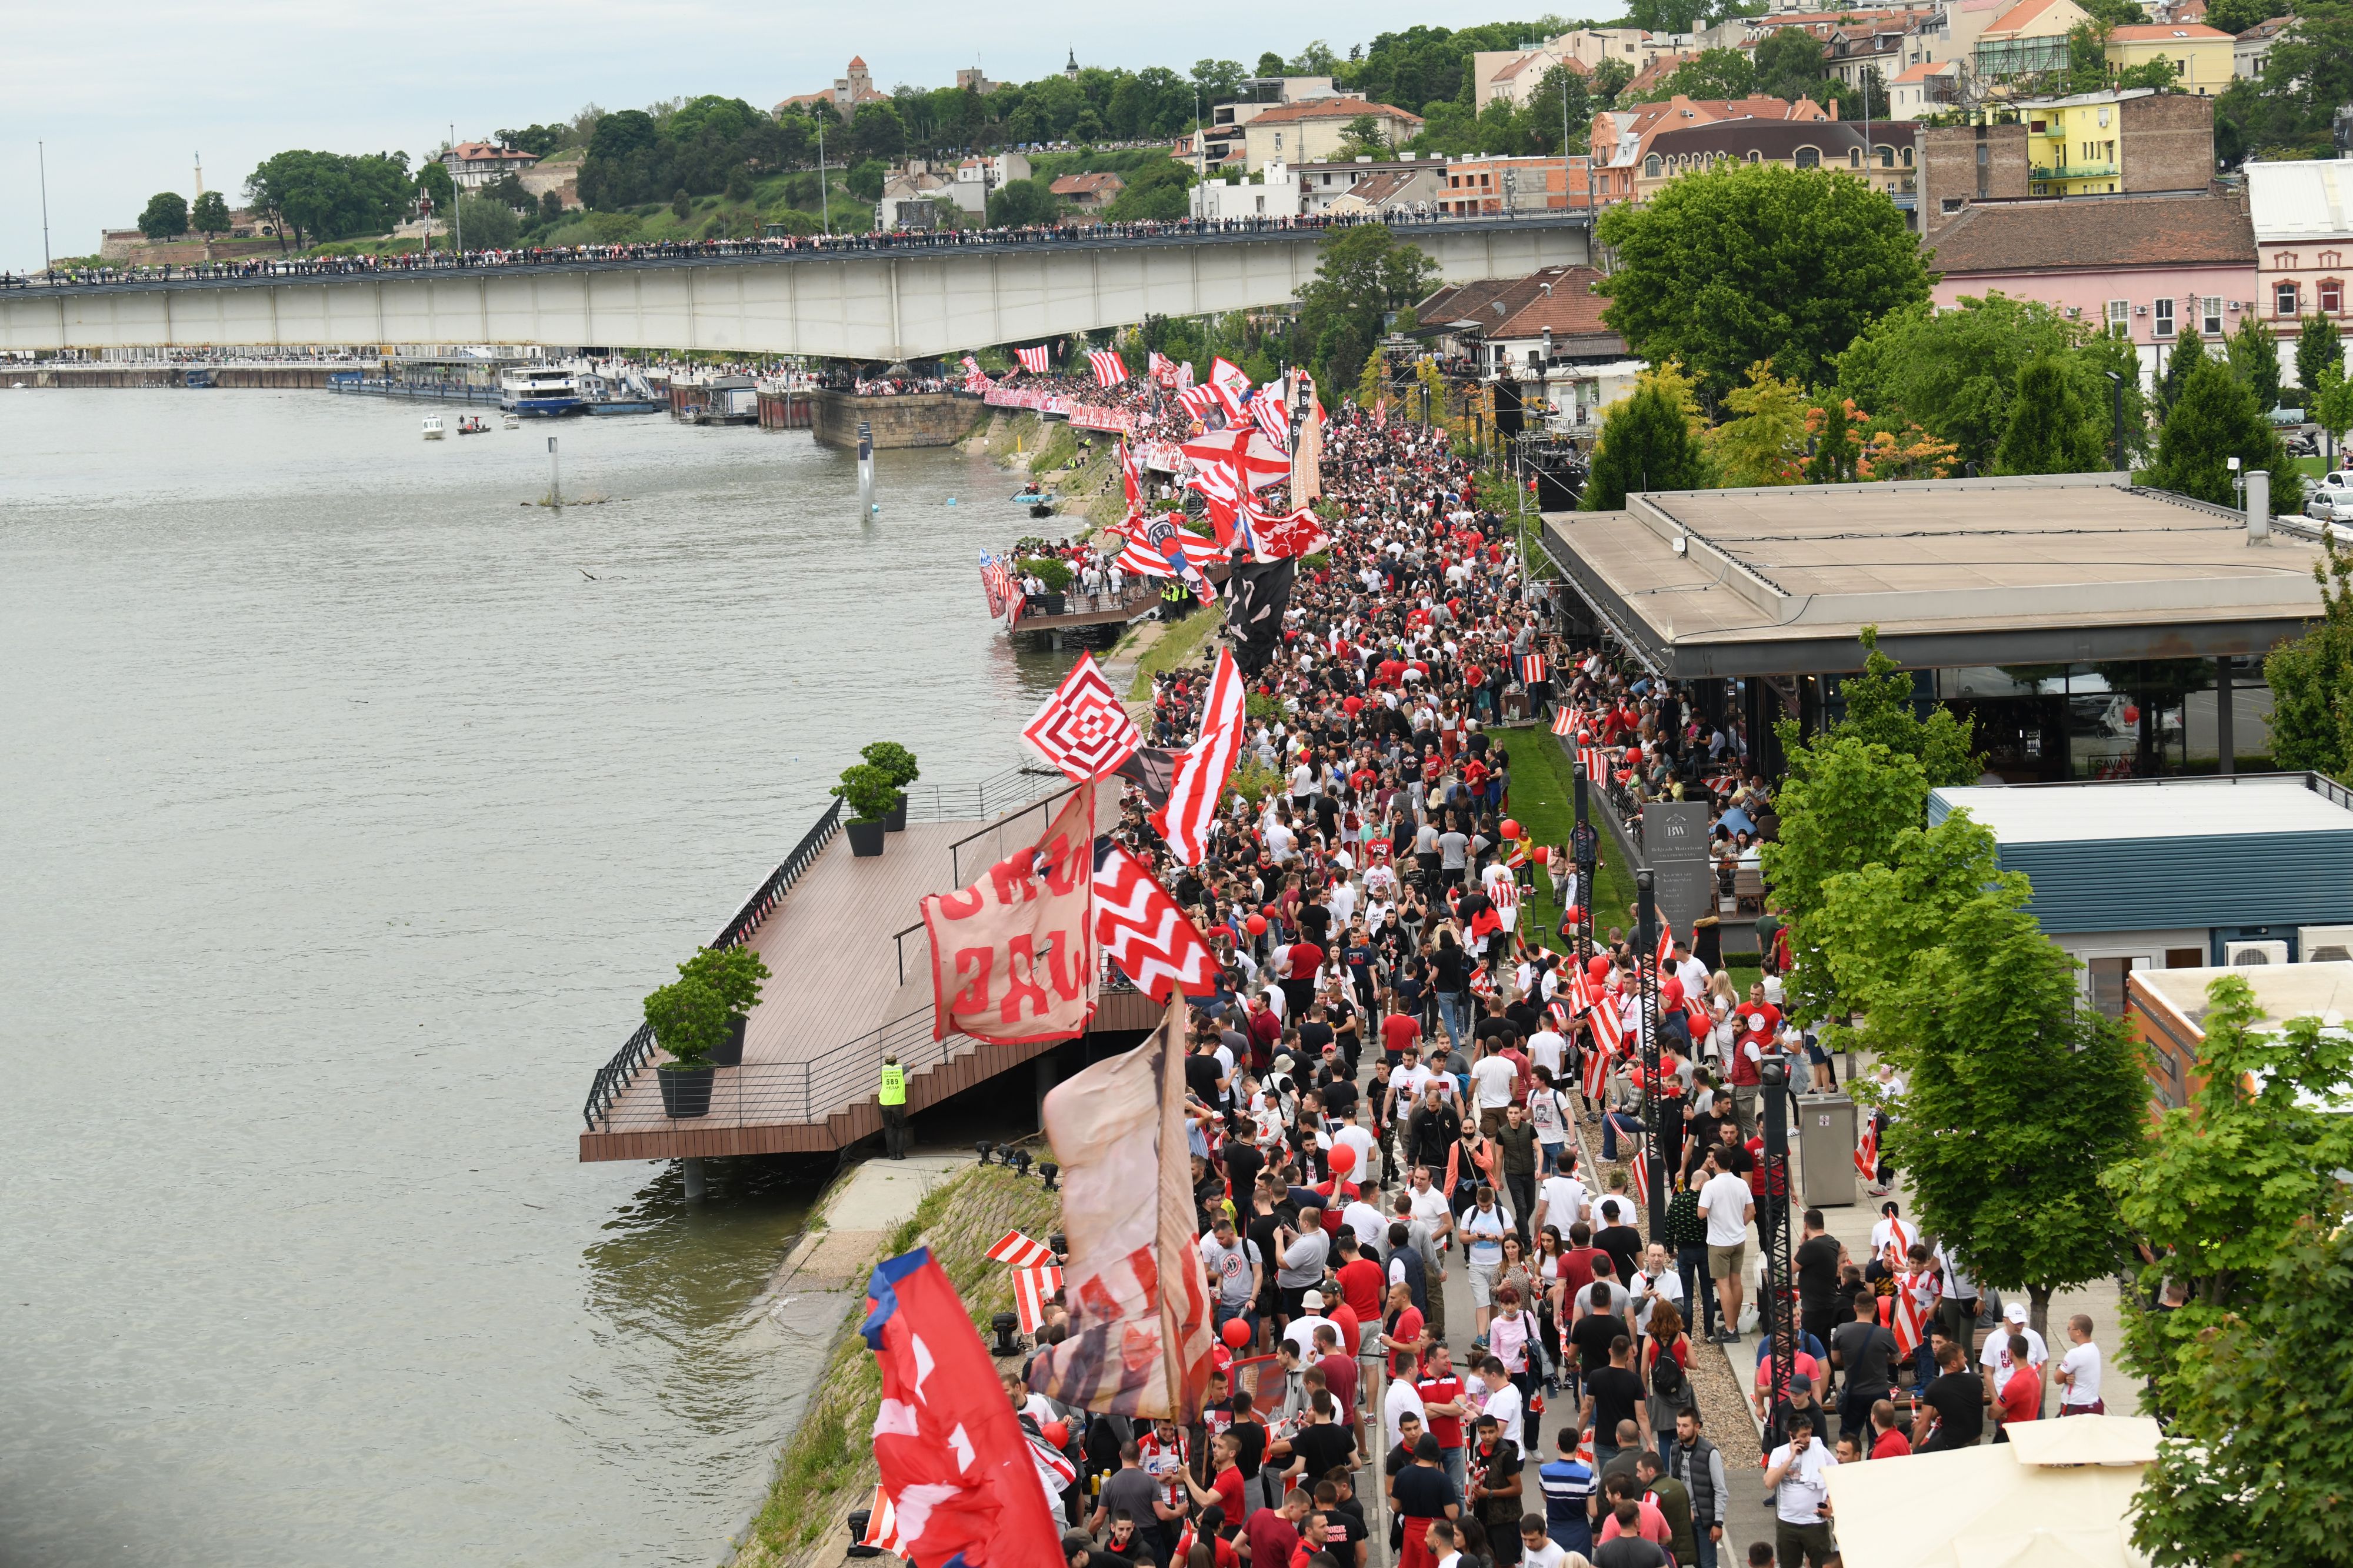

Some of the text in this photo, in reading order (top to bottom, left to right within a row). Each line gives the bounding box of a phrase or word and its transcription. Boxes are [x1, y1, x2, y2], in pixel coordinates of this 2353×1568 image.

[1301, 396, 1313, 405] BW
[1298, 413, 1313, 423] BW
[1292, 425, 1304, 436] BW
[1667, 826, 1684, 836] BW
